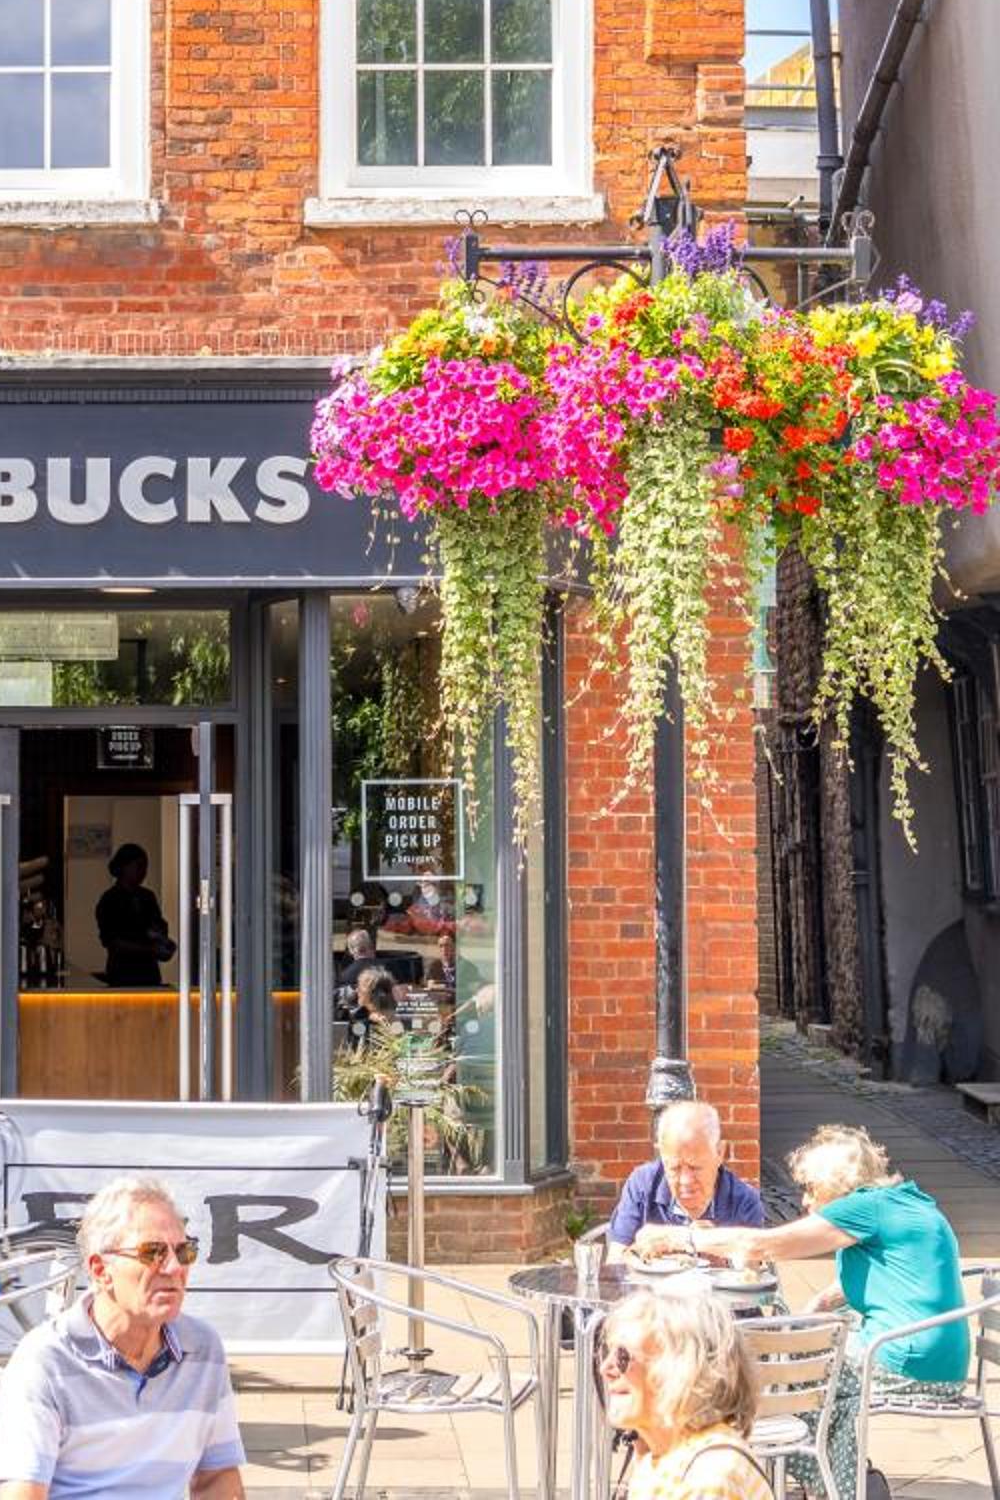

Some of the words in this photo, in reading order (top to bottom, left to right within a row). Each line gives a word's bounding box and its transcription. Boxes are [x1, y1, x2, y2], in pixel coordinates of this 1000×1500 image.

[385, 796, 440, 811] MOBILE
[389, 815, 437, 829] ORDER
[385, 833, 419, 848] PICK
[423, 833, 441, 848] UP
